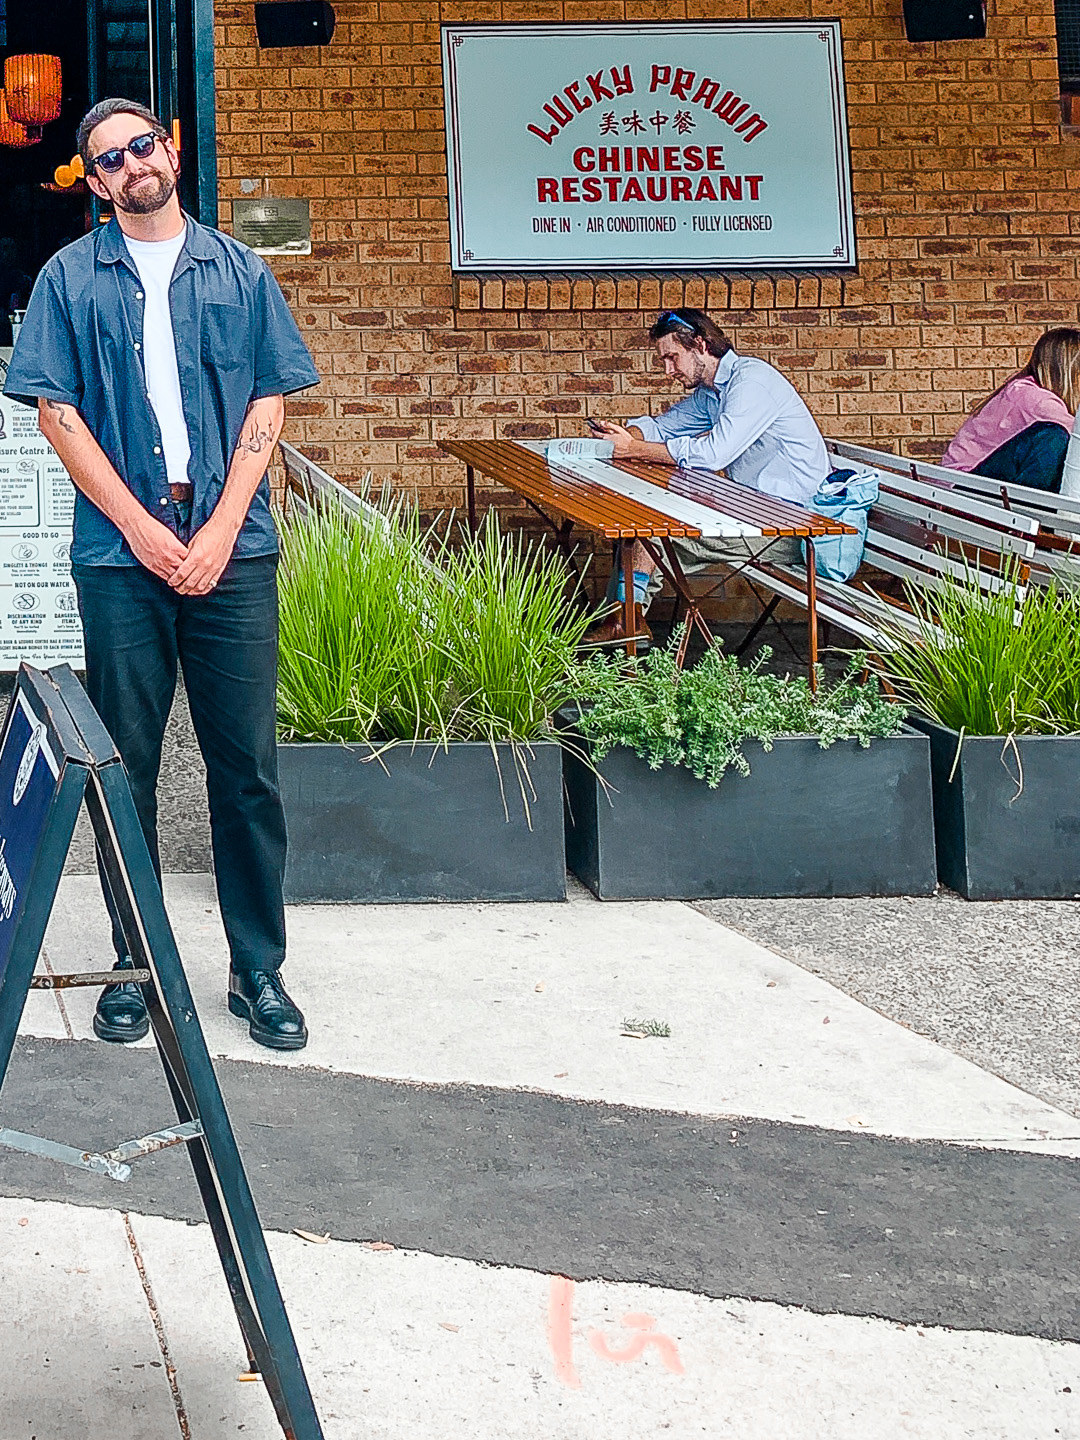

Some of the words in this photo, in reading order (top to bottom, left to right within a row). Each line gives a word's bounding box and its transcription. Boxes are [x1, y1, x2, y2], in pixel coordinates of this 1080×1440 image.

[527, 64, 635, 146] LUCKY
[649, 64, 769, 144] PRAWN
[598, 110, 697, 136] 美味中餐
[572, 145, 726, 173] CHINESE
[536, 175, 764, 203] RESTAURANT
[532, 217, 557, 233] DINE
[559, 217, 571, 233] IN
[586, 216, 604, 233] AIR
[607, 216, 677, 233] CONDITIONED
[692, 216, 722, 232] FULLY
[723, 215, 773, 231] LICENSED
[20, 446, 44, 455] Centre
